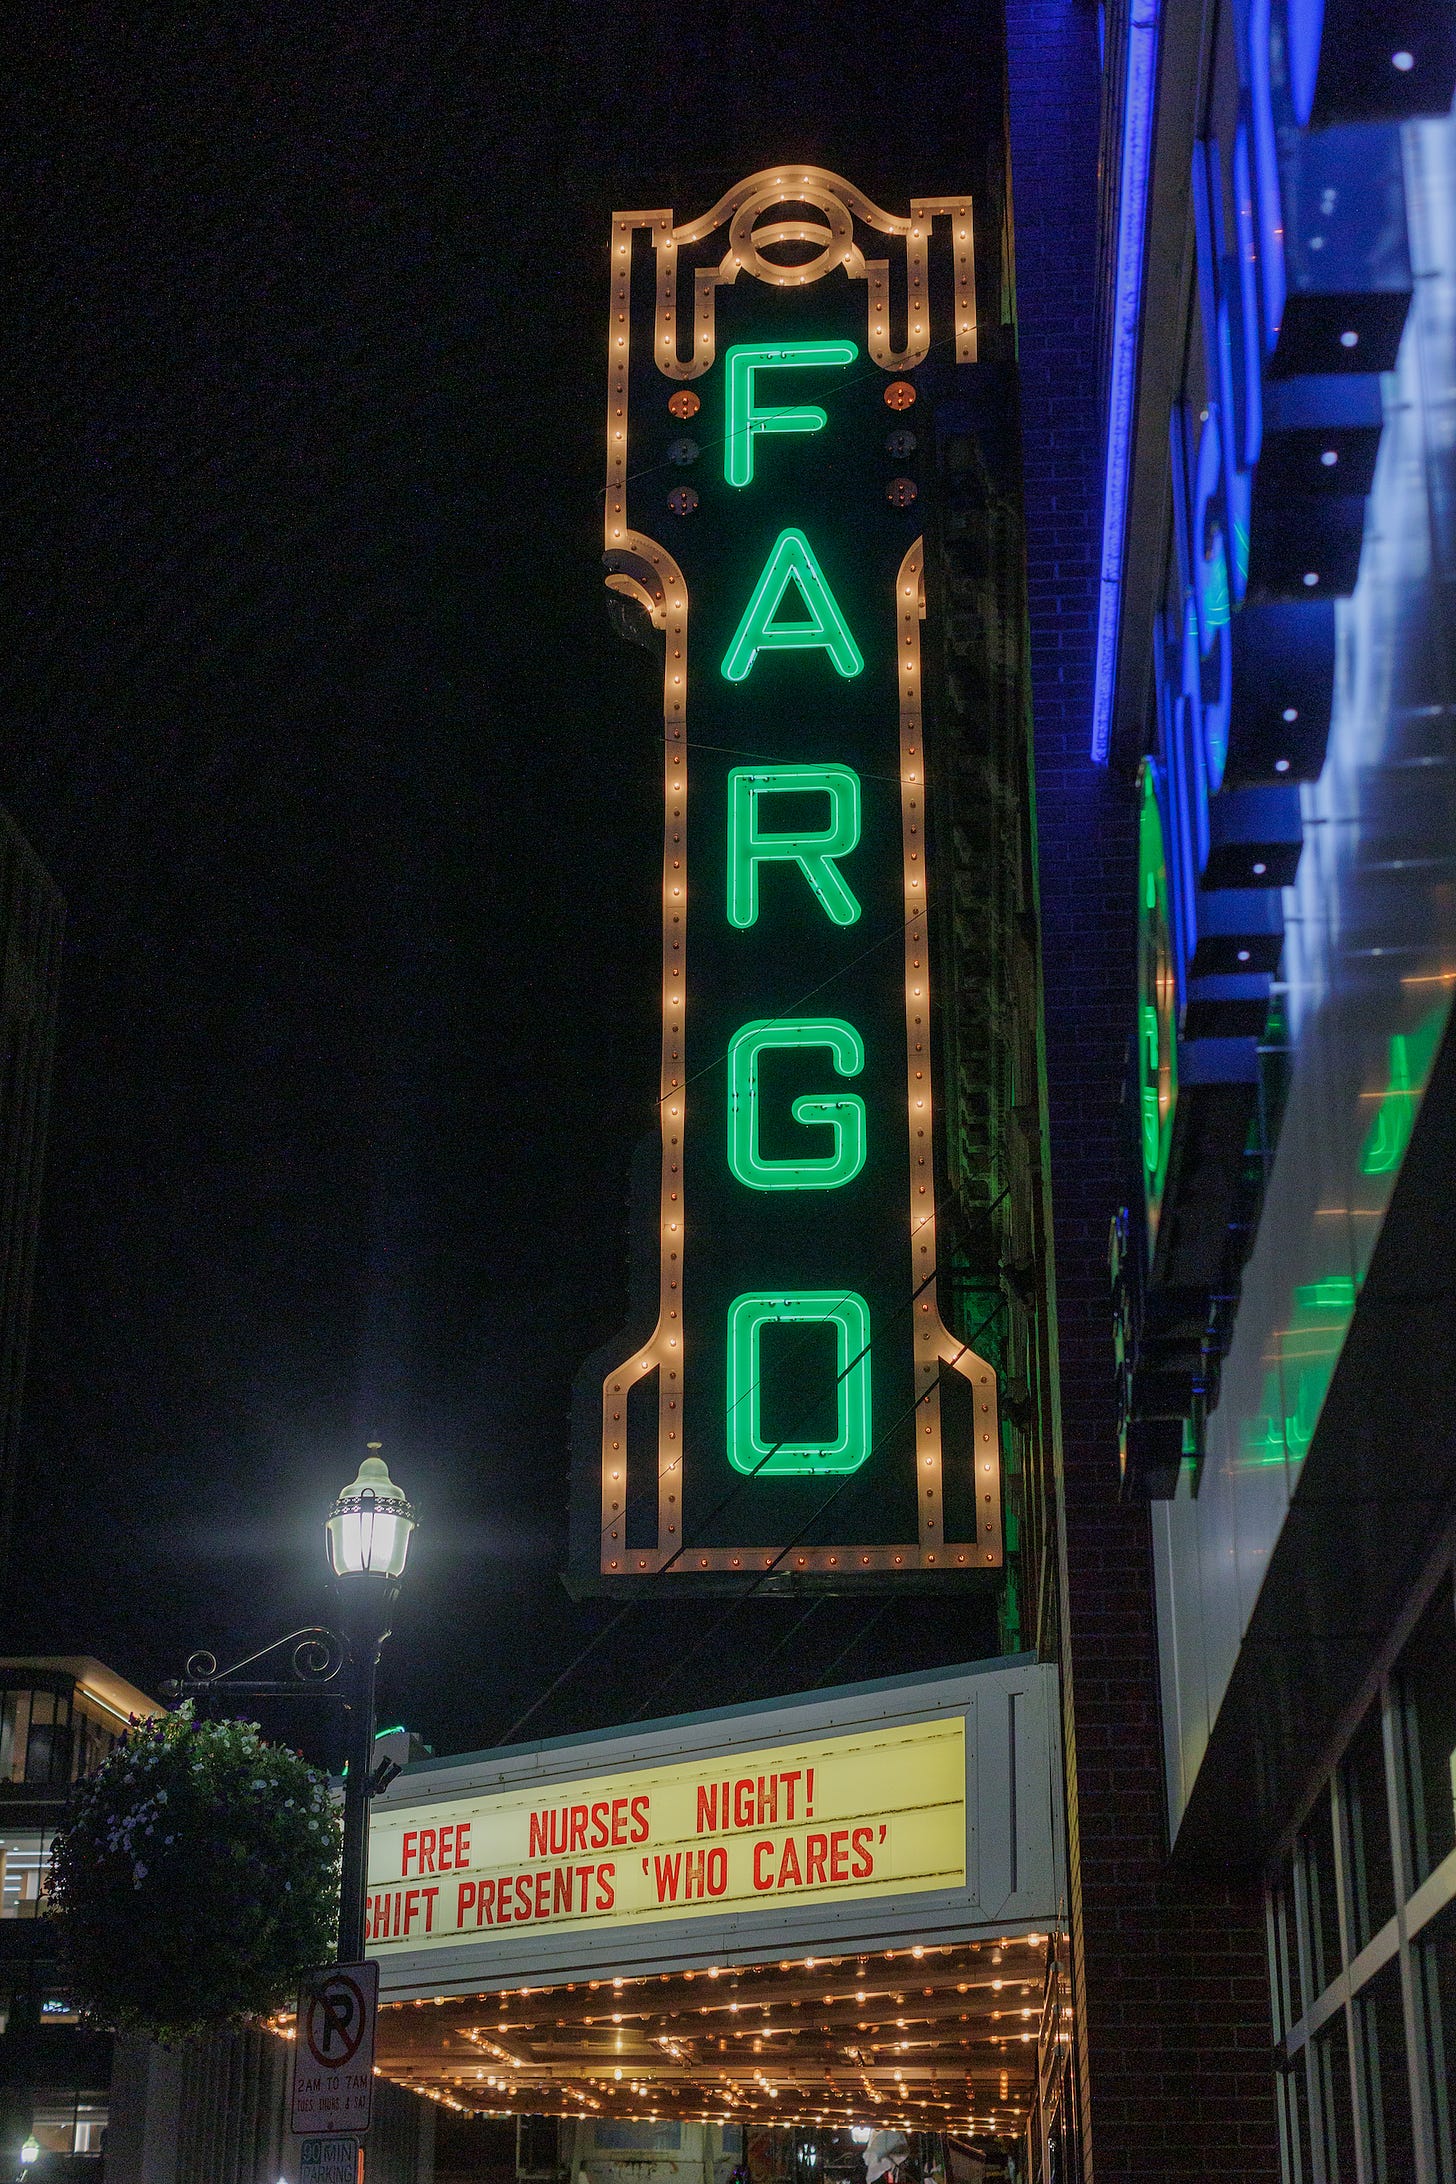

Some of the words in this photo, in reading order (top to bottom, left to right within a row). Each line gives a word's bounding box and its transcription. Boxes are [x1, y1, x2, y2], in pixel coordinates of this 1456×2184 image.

[721, 339, 873, 1477] FARGO
[401, 1823, 471, 1877] FREE
[529, 1796, 650, 1858] NURSES
[696, 1768, 815, 1834] NIGHT!
[457, 1863, 616, 1928] PRESENTS
[298, 2078, 321, 2093] 2AM
[326, 2076, 340, 2091] TO
[346, 2074, 368, 2089] 7AM
[302, 2163, 353, 2184] PARKING
[303, 2142, 321, 2161] 90
[324, 2142, 352, 2162] MIN
